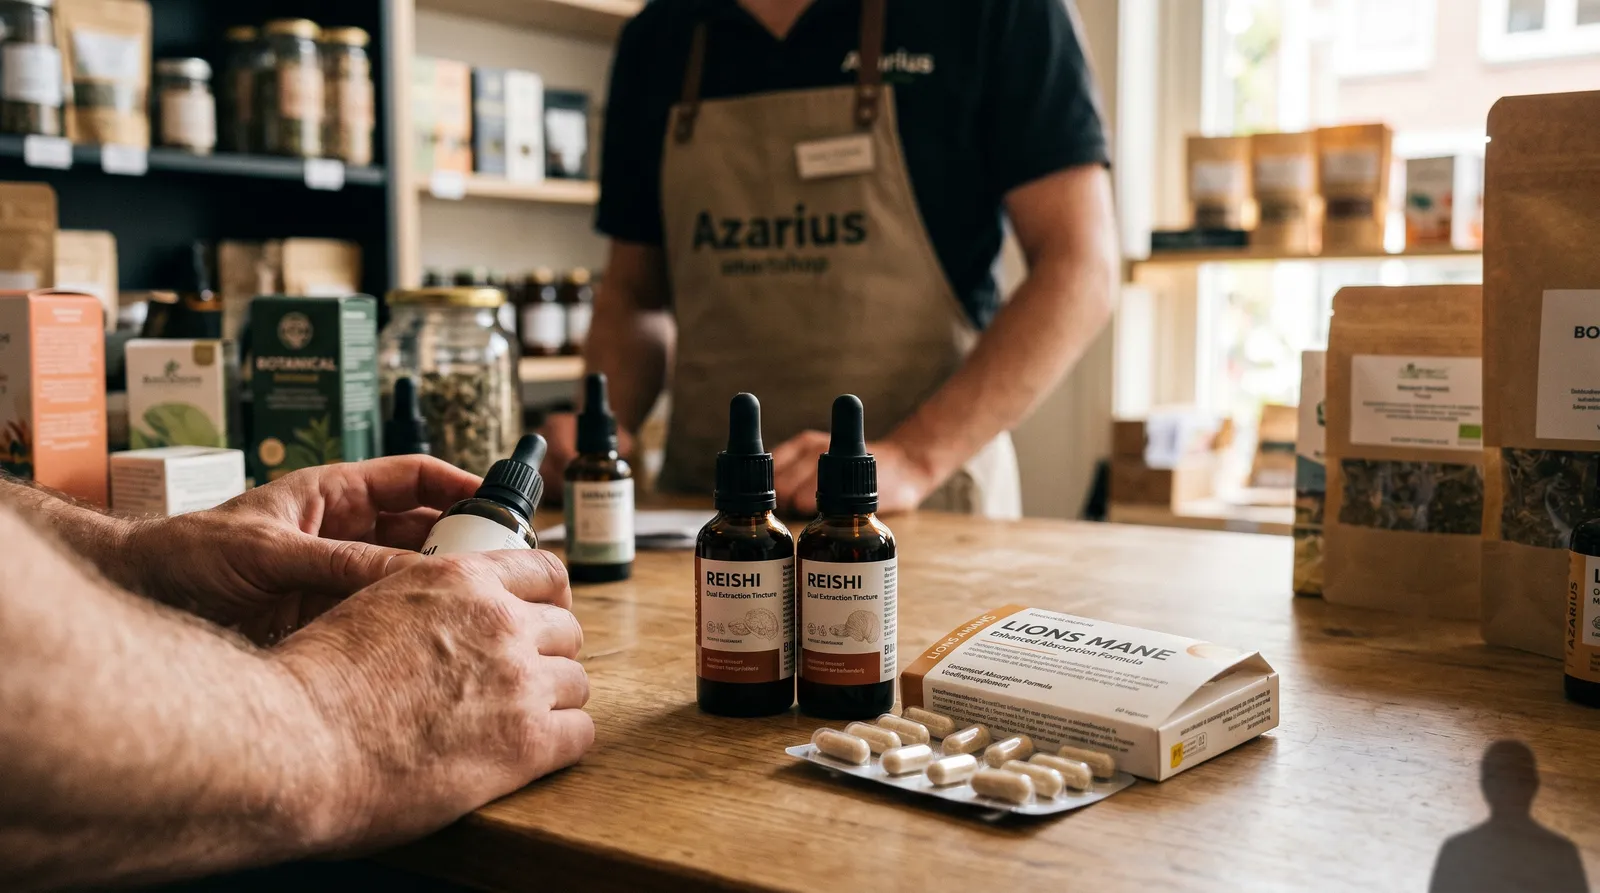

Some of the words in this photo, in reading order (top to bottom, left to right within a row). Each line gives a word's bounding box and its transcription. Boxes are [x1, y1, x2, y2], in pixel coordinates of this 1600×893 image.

[841, 47, 935, 75] Arius
[693, 204, 868, 251] Azarius
[706, 571, 761, 588] REISHI
[807, 572, 862, 590] REISHI
[706, 591, 718, 599] Dual
[718, 592, 751, 600] Extraction
[752, 591, 777, 599] Tincture
[807, 592, 819, 600] Dual
[819, 594, 852, 602] Extraction
[1567, 581, 1578, 650] AZARIUS
[926, 636, 959, 661] LIONS
[990, 630, 1039, 646] Enhanced
[1038, 640, 1097, 657] Absorption
[1097, 652, 1144, 666] Formula
[1001, 620, 1085, 643] LIONS
[1085, 636, 1177, 662] MANE
[984, 670, 1023, 683] Absorption
